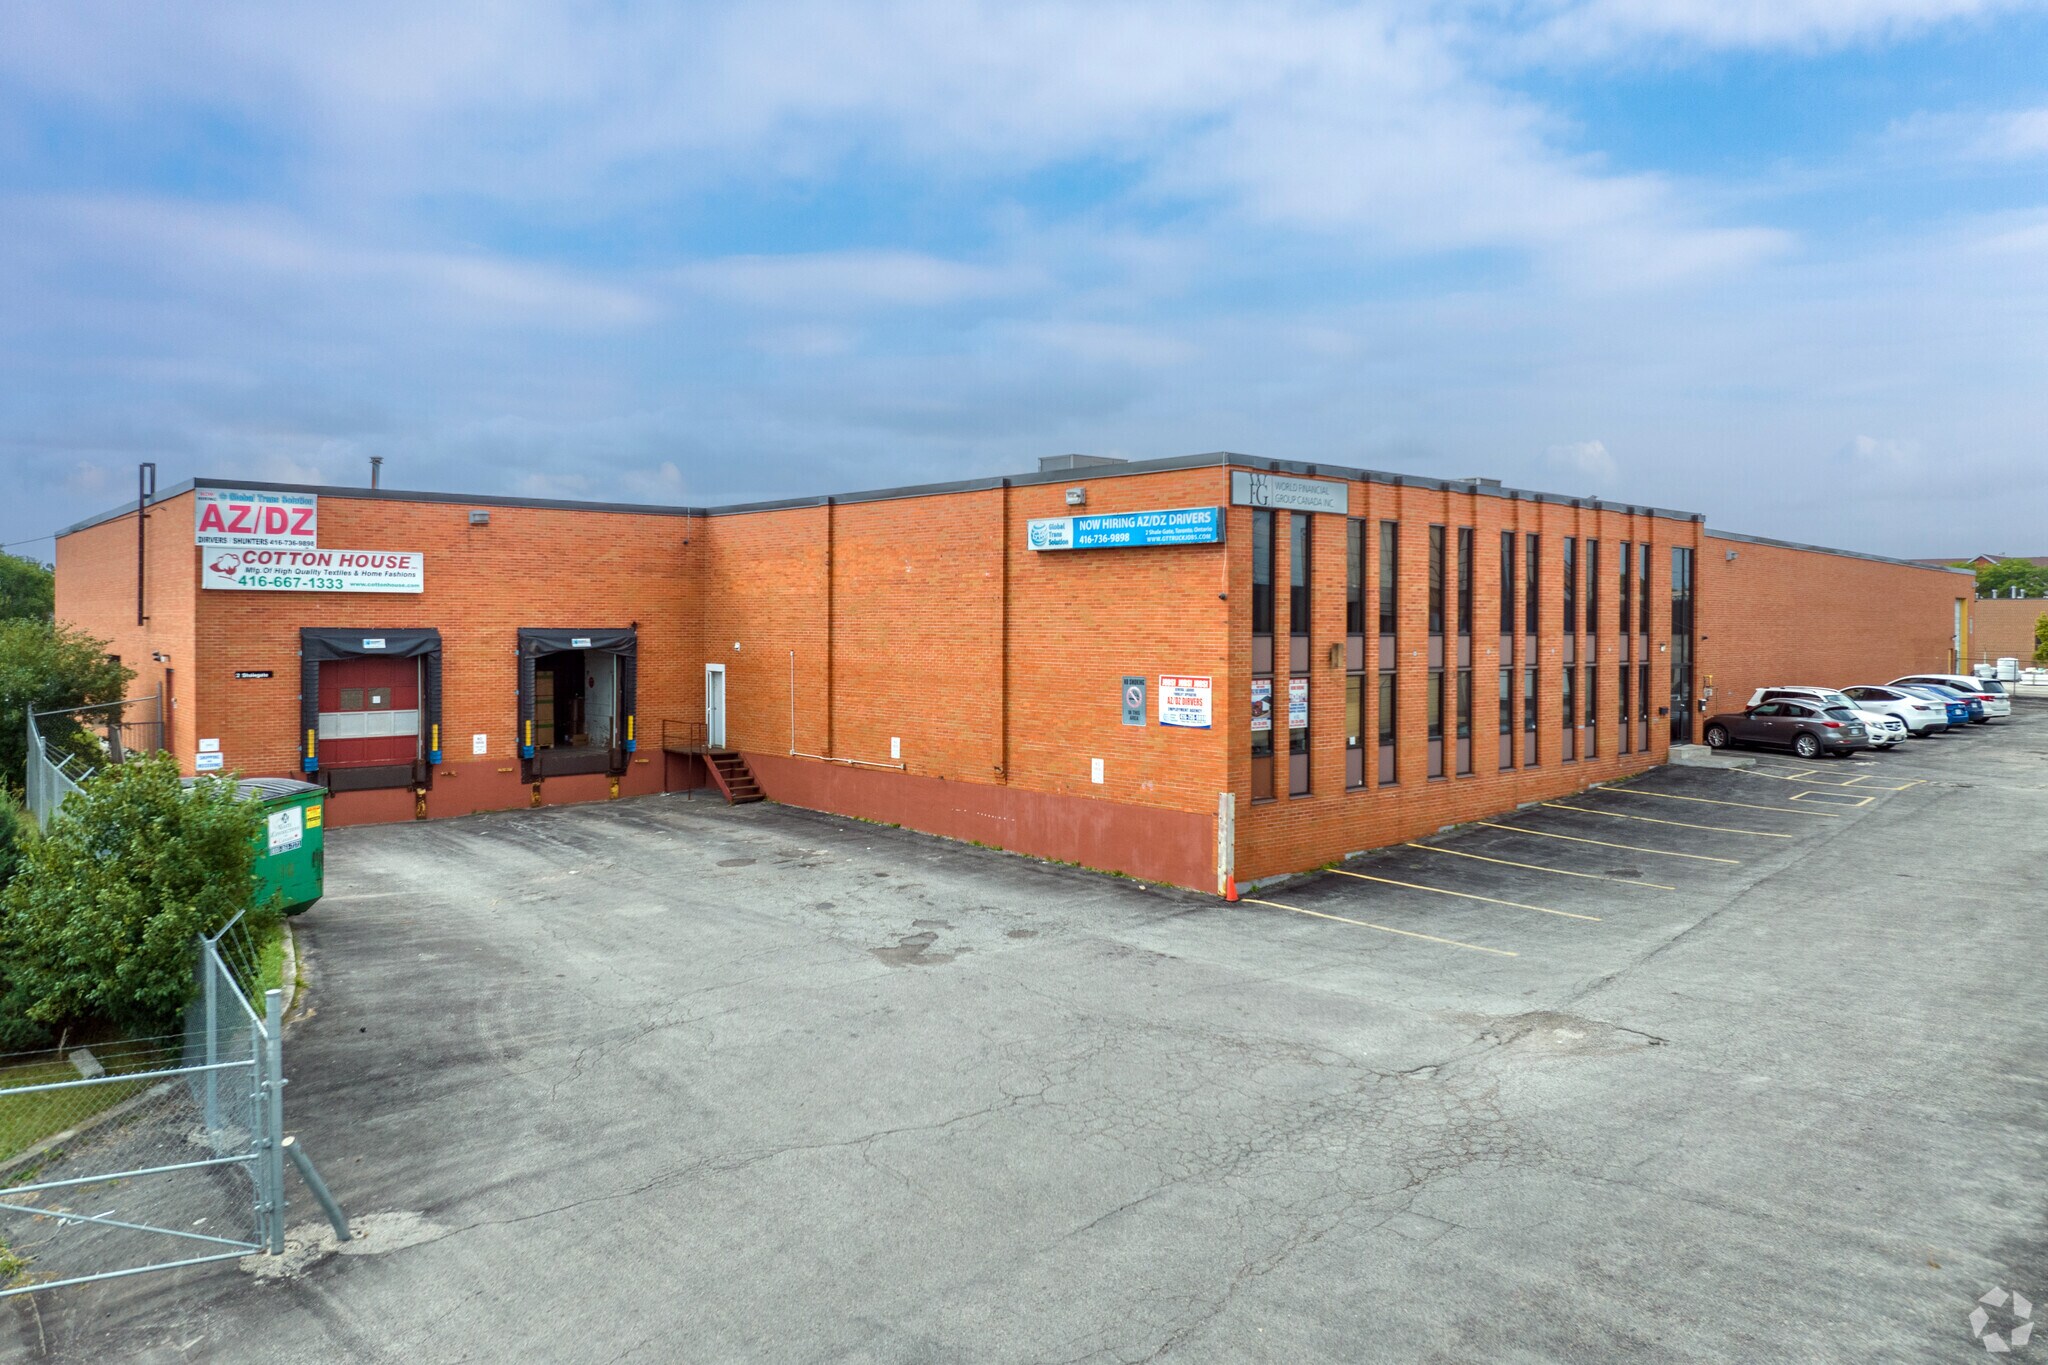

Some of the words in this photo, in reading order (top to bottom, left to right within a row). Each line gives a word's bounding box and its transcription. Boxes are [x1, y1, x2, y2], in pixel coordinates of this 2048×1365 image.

[1275, 481, 1297, 492] WORLD
[1298, 484, 1330, 495] FINANCIAL
[1275, 494, 1296, 503] GROUP
[1297, 496, 1322, 506] CANADA
[198, 503, 315, 536] AZ/DZ
[1079, 519, 1101, 531] NOW
[1102, 516, 1135, 530] HIRING
[1136, 514, 1167, 528] AZ/DZ
[1169, 511, 1211, 525] DRIVERS
[233, 537, 268, 546] SHUNTERS
[1048, 538, 1069, 546] Solution
[1079, 533, 1130, 544] 416-736-9898
[242, 549, 333, 567] COTTON
[338, 554, 411, 569] HOUSE
[275, 568, 292, 576] High
[295, 568, 321, 577] Quality
[238, 575, 343, 589] 416-667-1333
